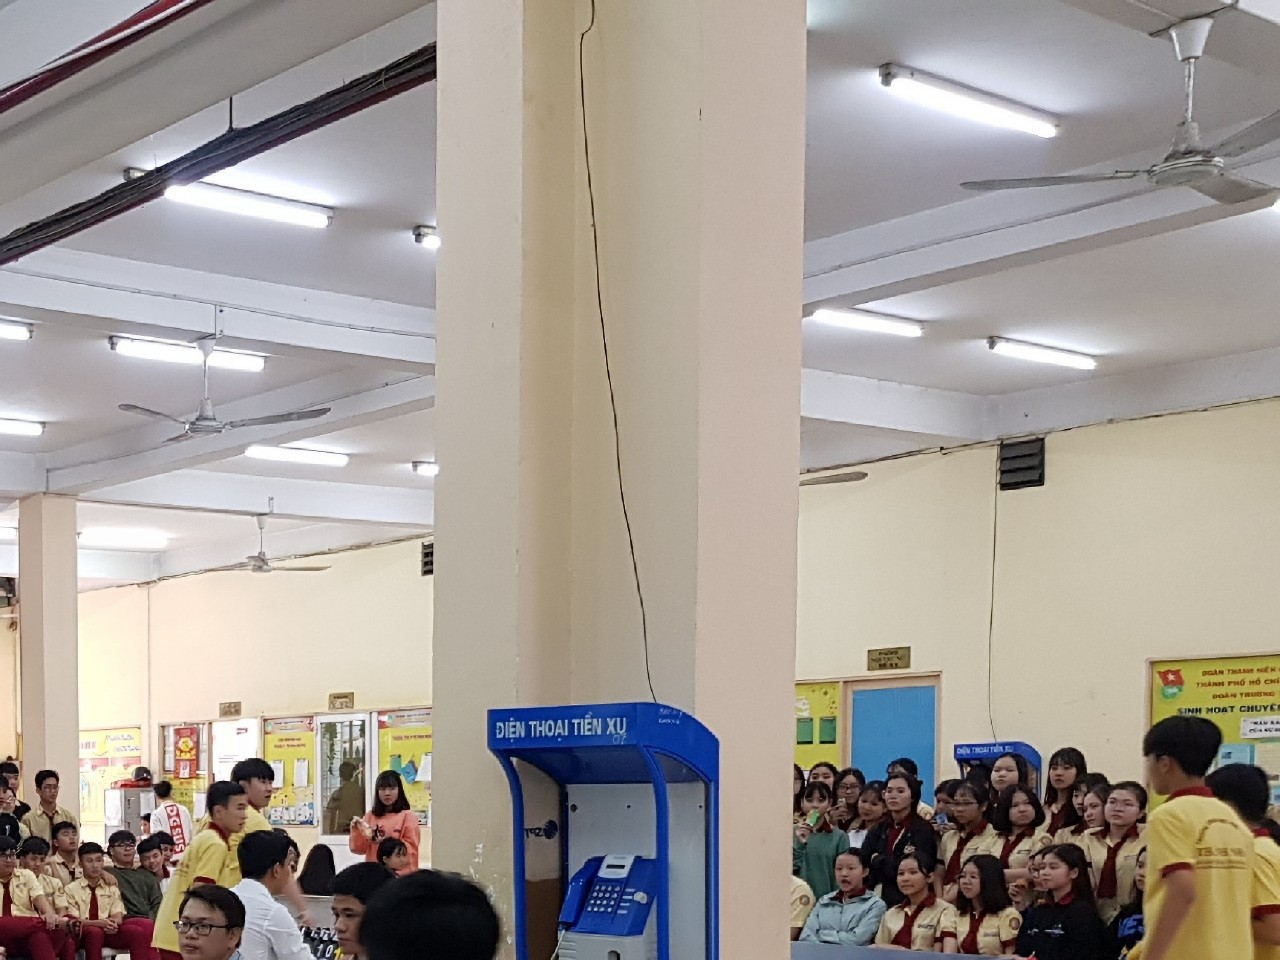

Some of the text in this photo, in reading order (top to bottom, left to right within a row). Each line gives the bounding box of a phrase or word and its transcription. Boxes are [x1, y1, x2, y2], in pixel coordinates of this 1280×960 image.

[496, 711, 627, 743] ĐIỆN THOẠI TIỀN XU
